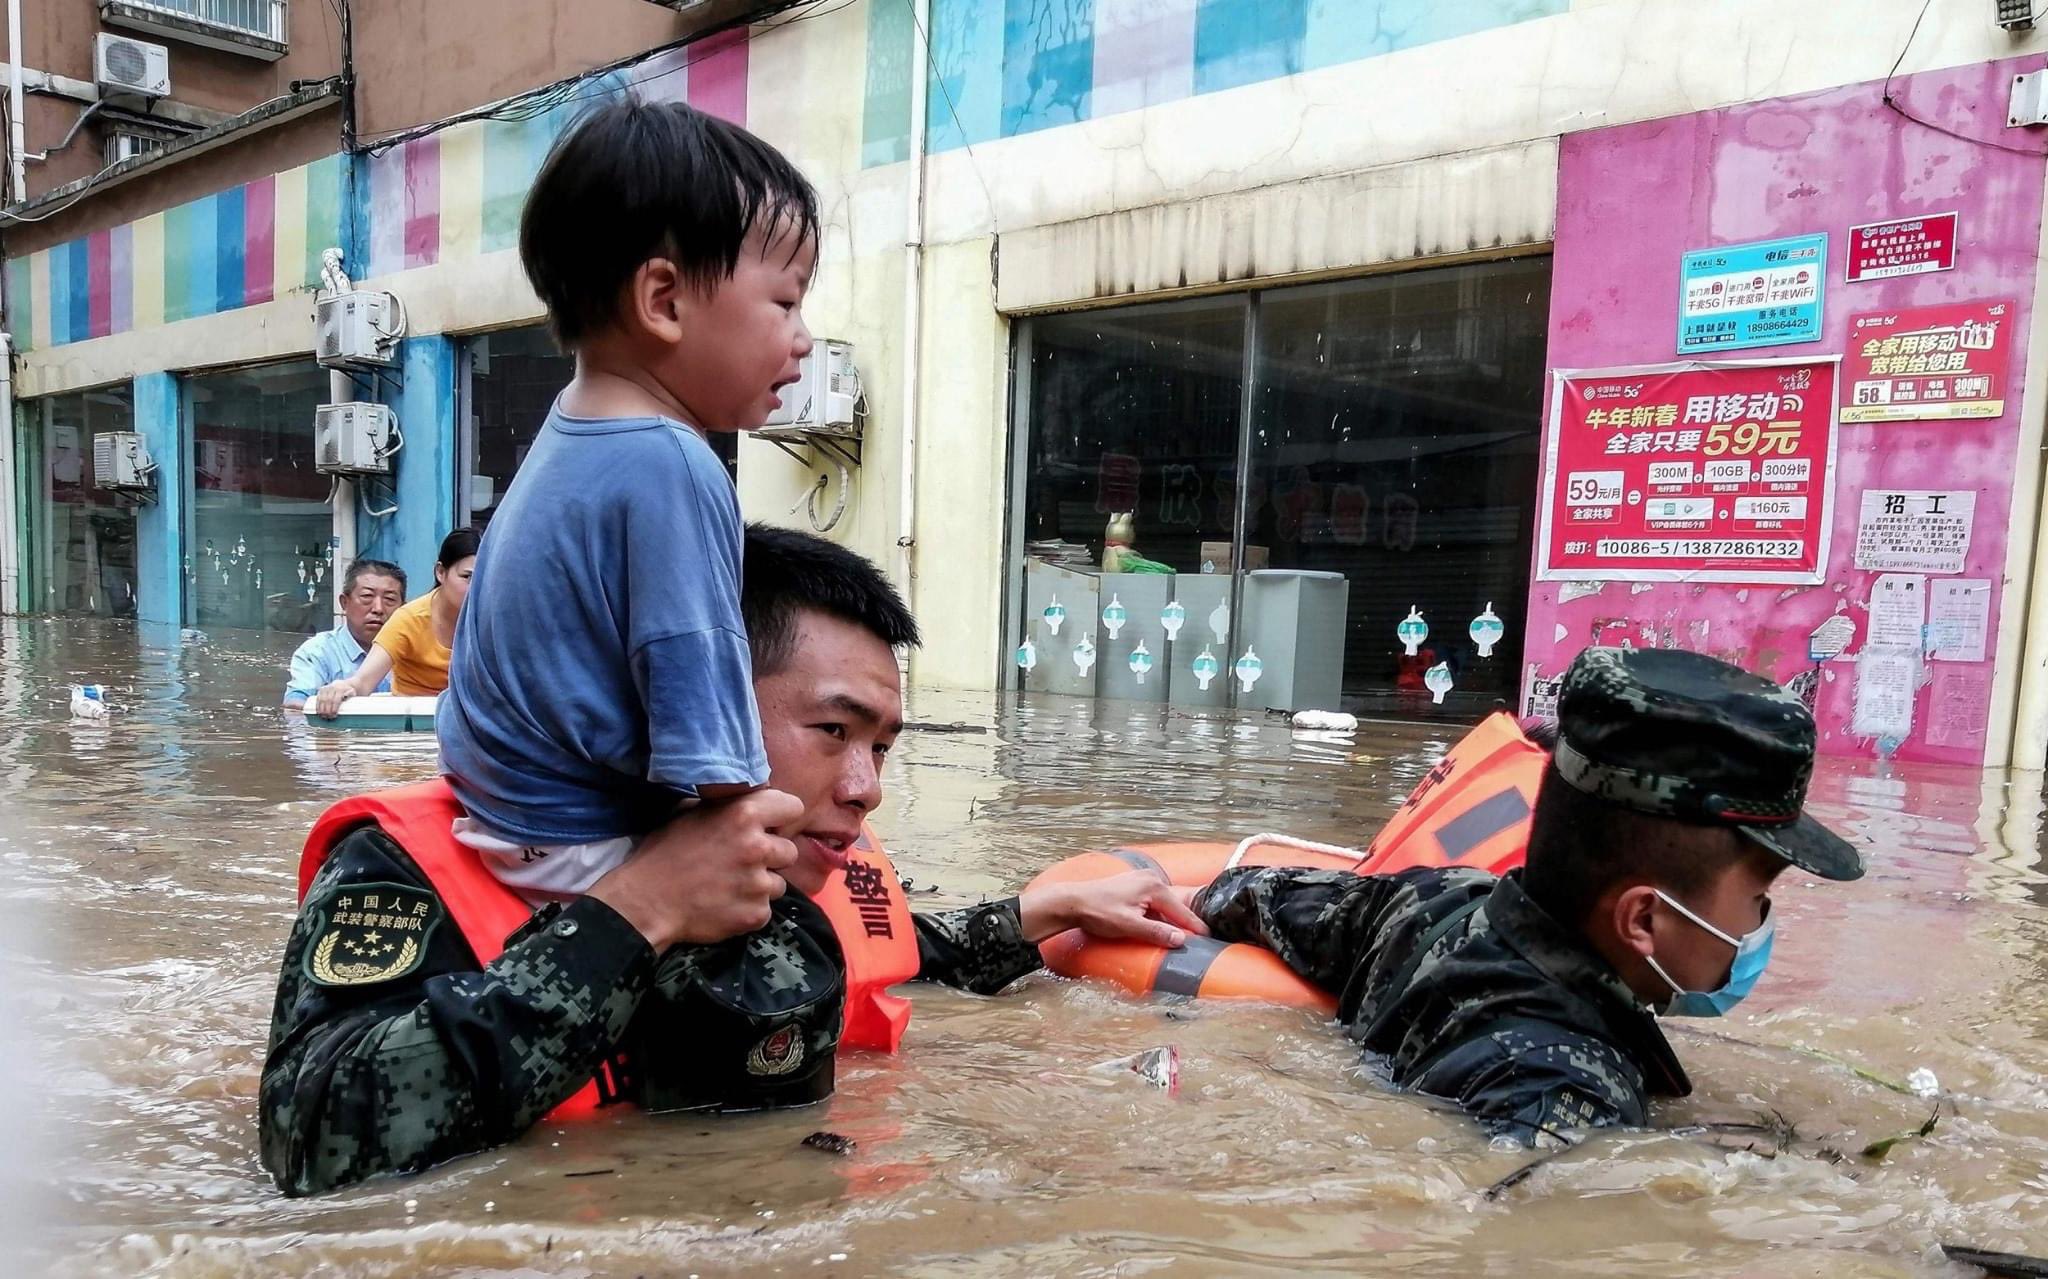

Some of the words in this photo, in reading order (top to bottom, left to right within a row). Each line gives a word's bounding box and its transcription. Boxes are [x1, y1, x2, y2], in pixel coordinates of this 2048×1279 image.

[1747, 318, 1809, 333] 18908664429
[1862, 334, 1958, 357] 全家用移动
[1869, 352, 1968, 375] 宽带给您用
[1859, 388, 1880, 404] 58
[1585, 404, 1679, 430] 牛年新春
[1683, 393, 1779, 425] 用移动
[1654, 466, 1688, 479] 300M
[1711, 465, 1744, 478] 10GB
[1765, 463, 1808, 477] 300分钟
[1569, 479, 1621, 501] 59元/月
[1757, 502, 1791, 514] 160元
[1885, 494, 1947, 516] 招工
[1573, 508, 1613, 521] 全家共享
[338, 895, 429, 918] 中国人民
[331, 912, 423, 932] 武装警察部队
